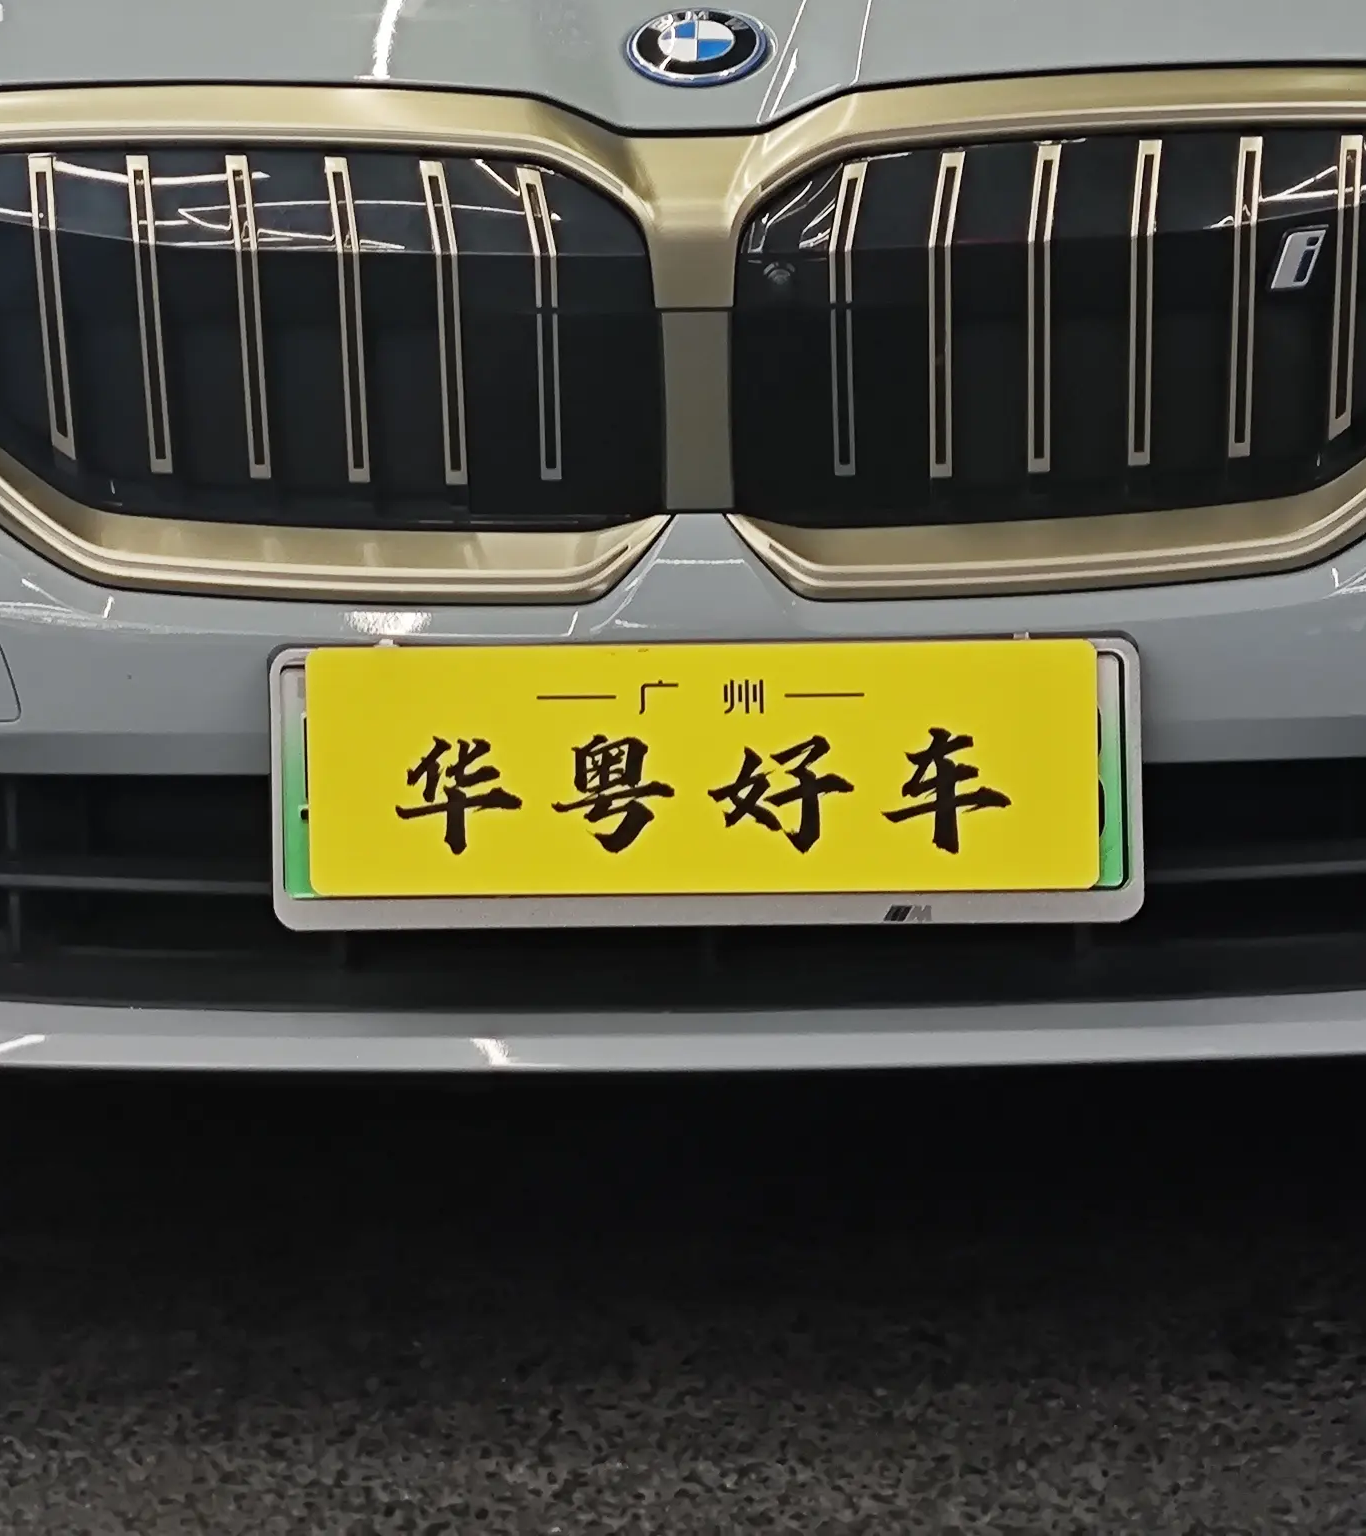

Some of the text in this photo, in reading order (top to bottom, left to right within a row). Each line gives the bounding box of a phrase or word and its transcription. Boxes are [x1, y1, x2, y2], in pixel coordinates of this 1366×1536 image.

[638, 678, 766, 714] 广州
[395, 726, 1011, 854] 华粤好车
